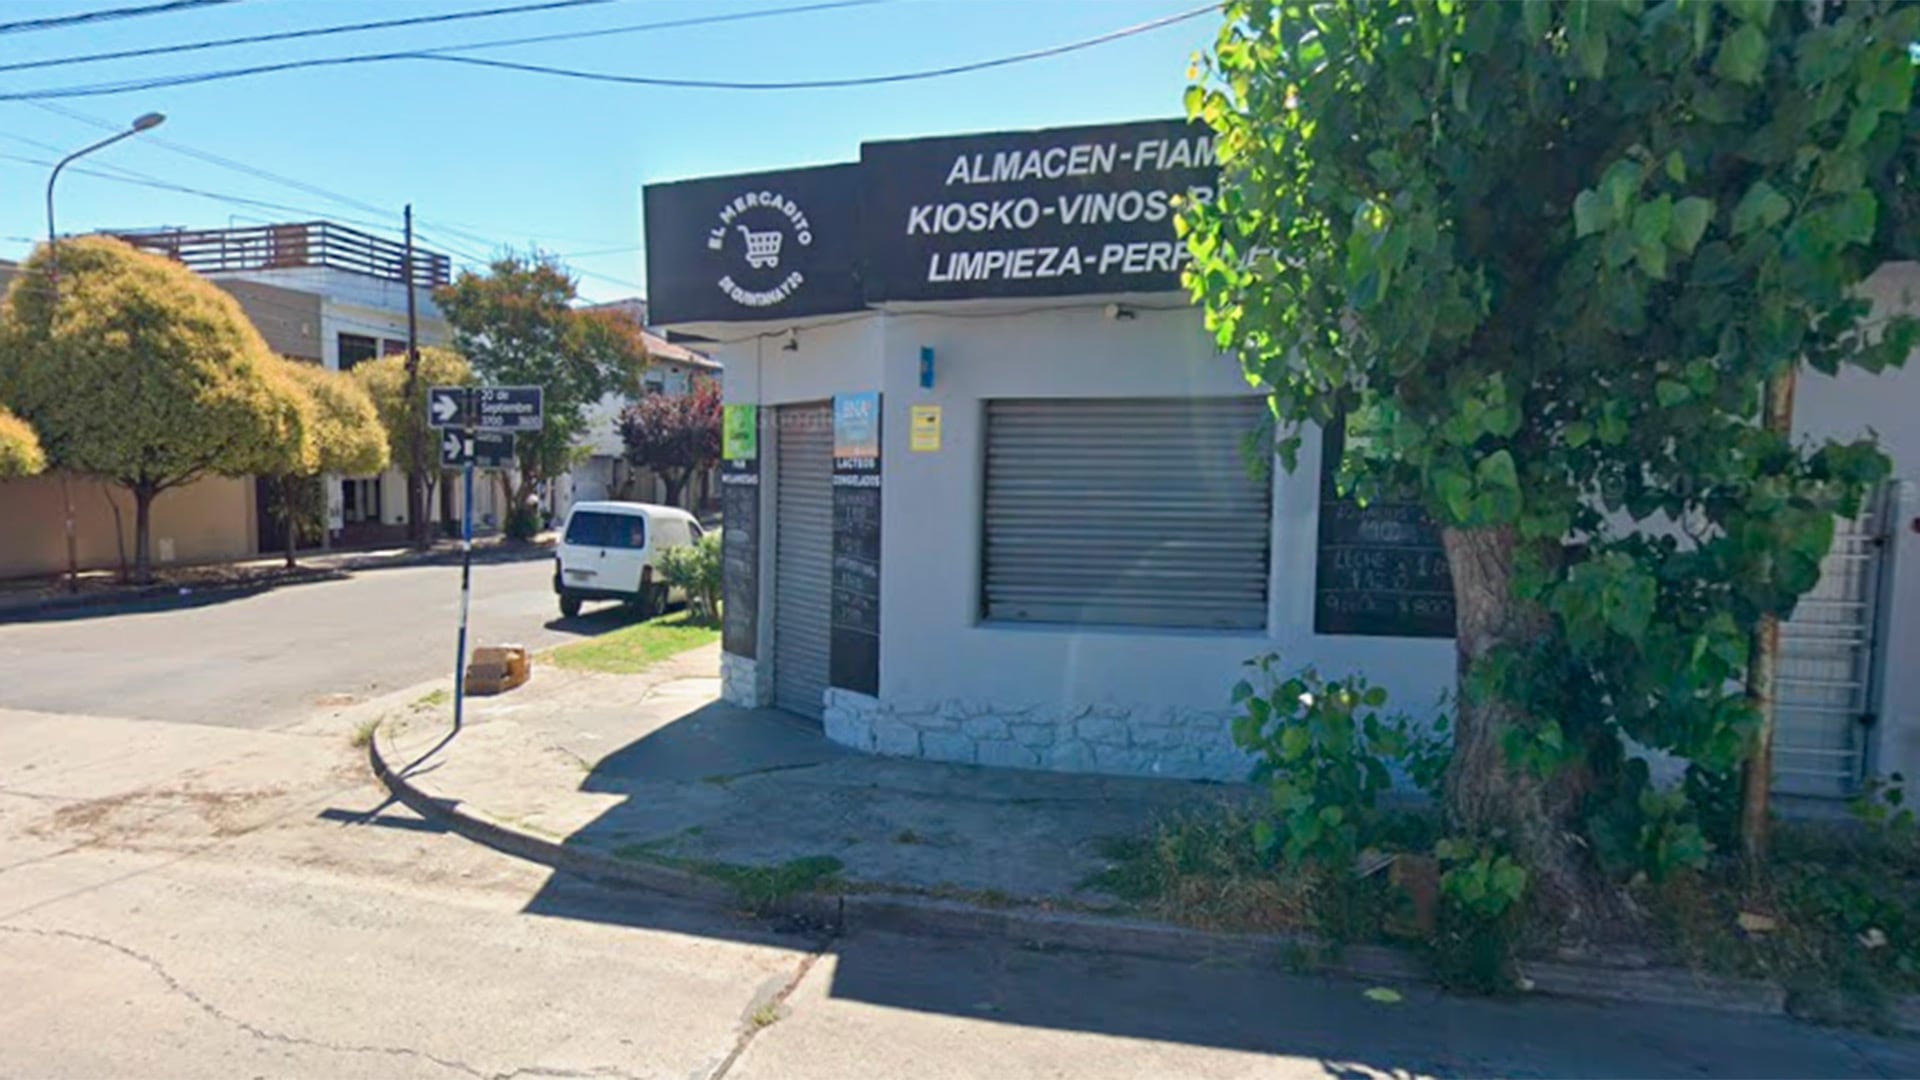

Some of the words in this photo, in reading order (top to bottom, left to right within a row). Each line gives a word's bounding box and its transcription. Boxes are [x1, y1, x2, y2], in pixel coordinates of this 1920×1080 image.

[707, 226, 727, 250] EL
[719, 190, 813, 246] MERCADITO
[496, 391, 509, 400] de
[481, 402, 534, 415] Septiembre
